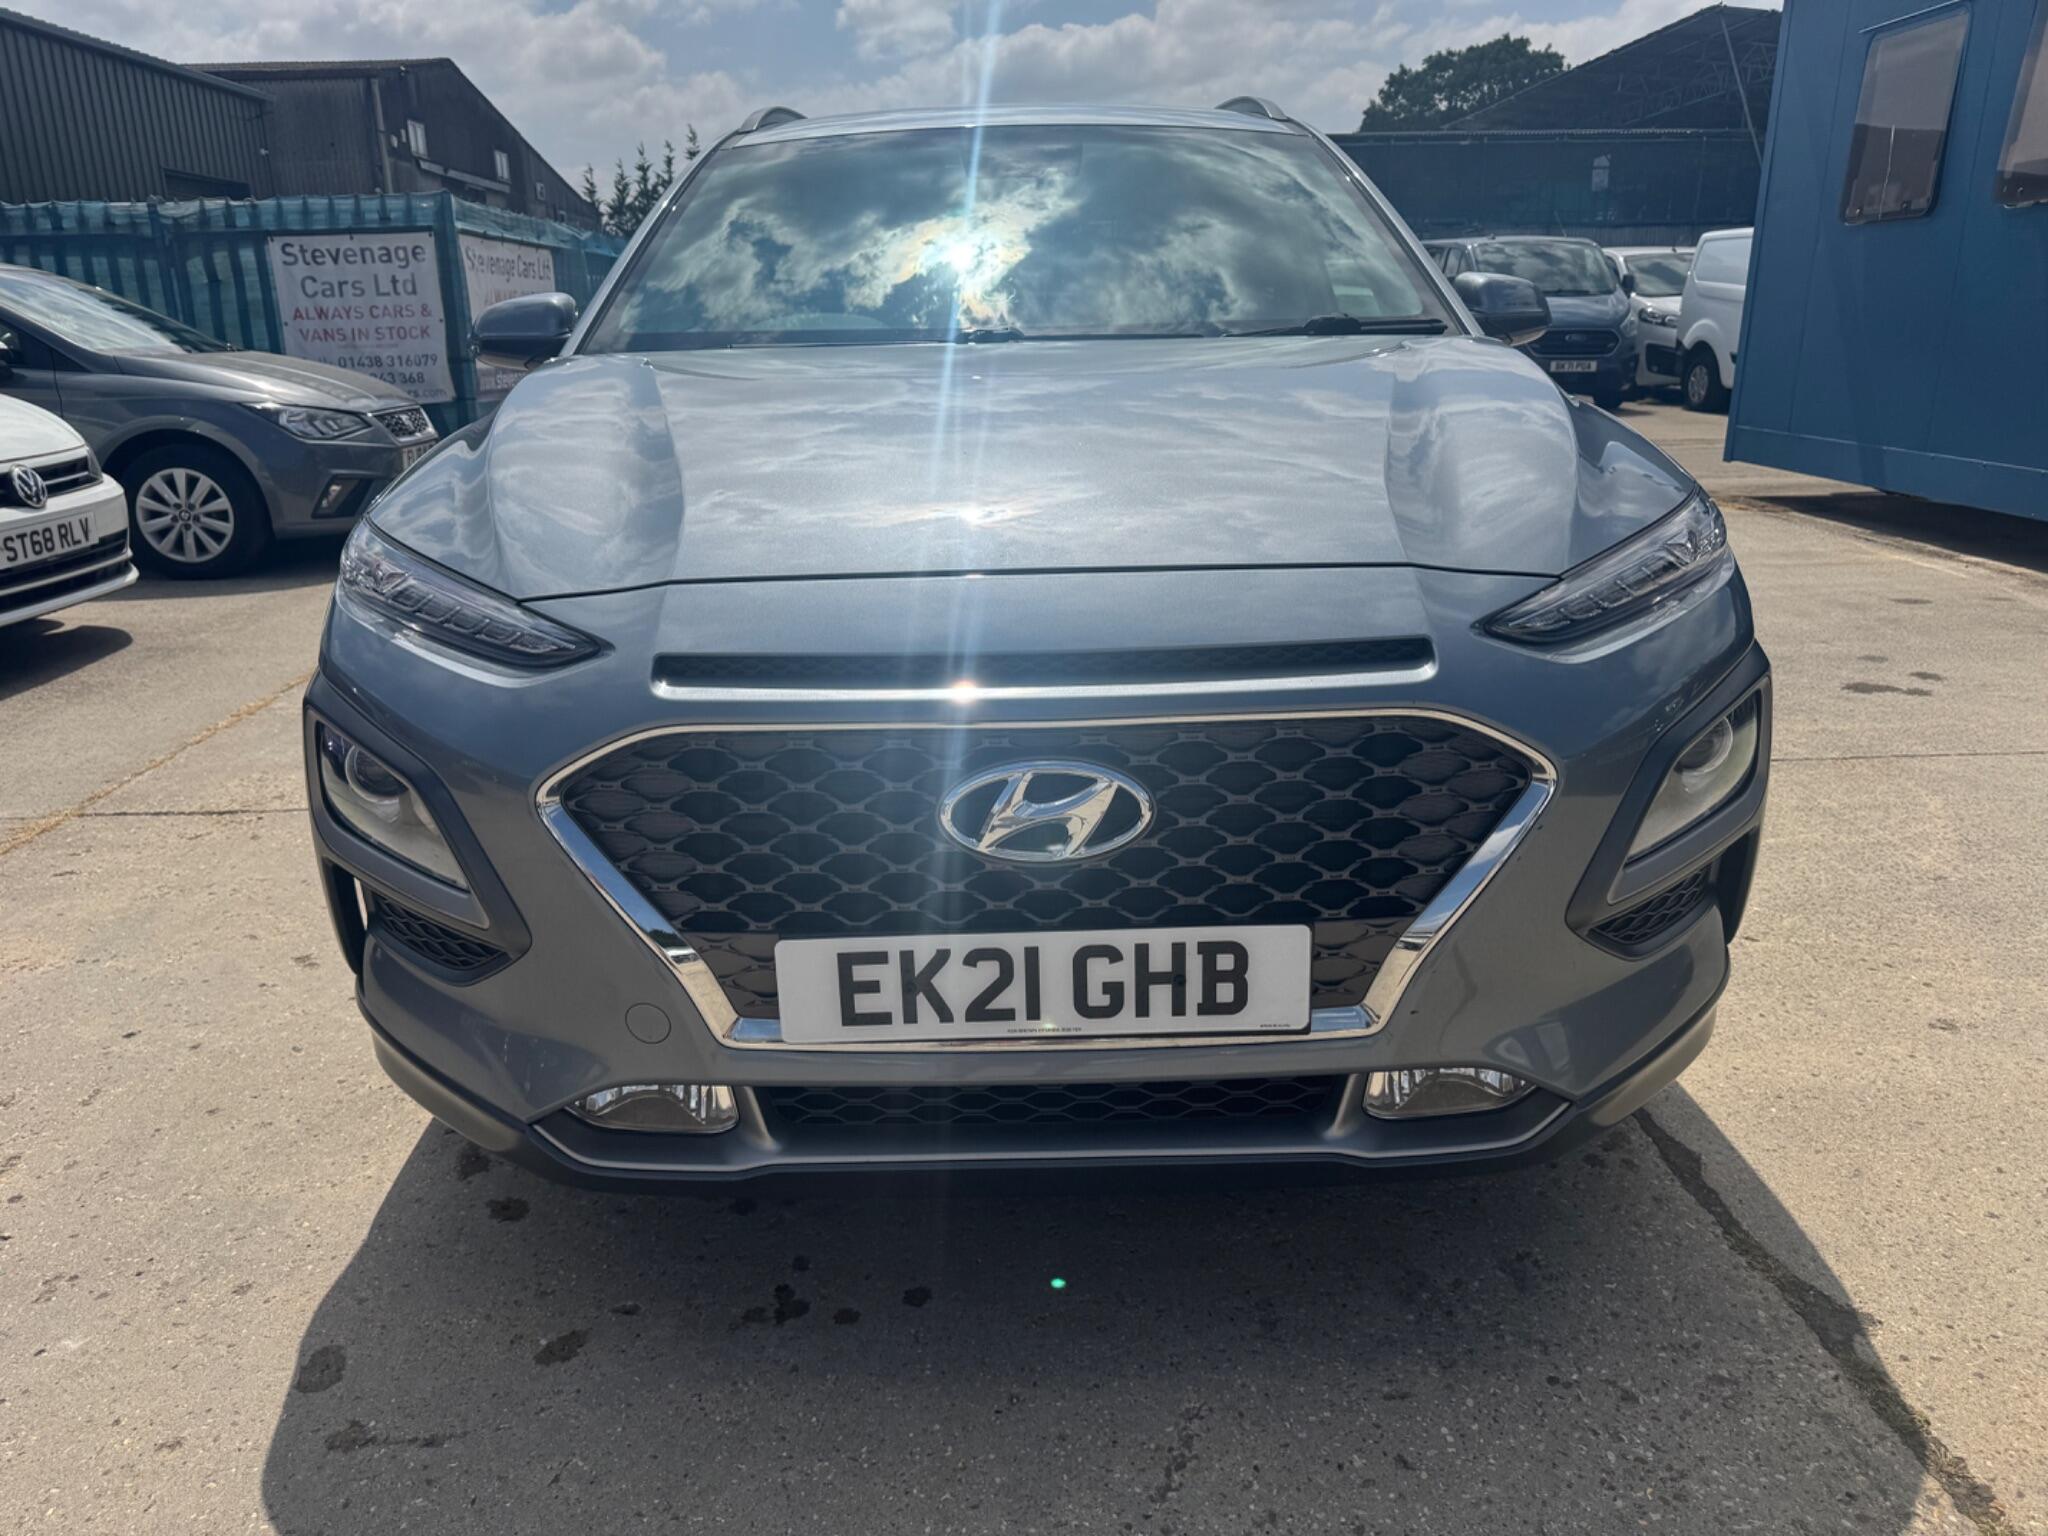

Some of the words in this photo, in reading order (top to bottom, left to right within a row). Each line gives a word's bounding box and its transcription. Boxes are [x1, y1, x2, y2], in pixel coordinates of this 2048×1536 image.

[281, 243, 426, 269] Stevenage
[516, 254, 536, 280] Cars
[300, 275, 365, 298] Cars
[374, 273, 418, 296] Ltd
[293, 305, 364, 321] ALWAYS
[369, 304, 416, 319] CARS
[420, 303, 432, 318] &
[299, 327, 347, 342] VANS
[351, 326, 370, 341] IN
[375, 325, 431, 341] STOCK
[338, 355, 383, 368] 01438
[386, 353, 438, 368] 316079
[399, 371, 426, 384] 368
[3, 527, 55, 562] ST68
[57, 517, 90, 549] RLV
[837, 945, 1041, 1026] EK21
[1072, 940, 1250, 1020] GHB
